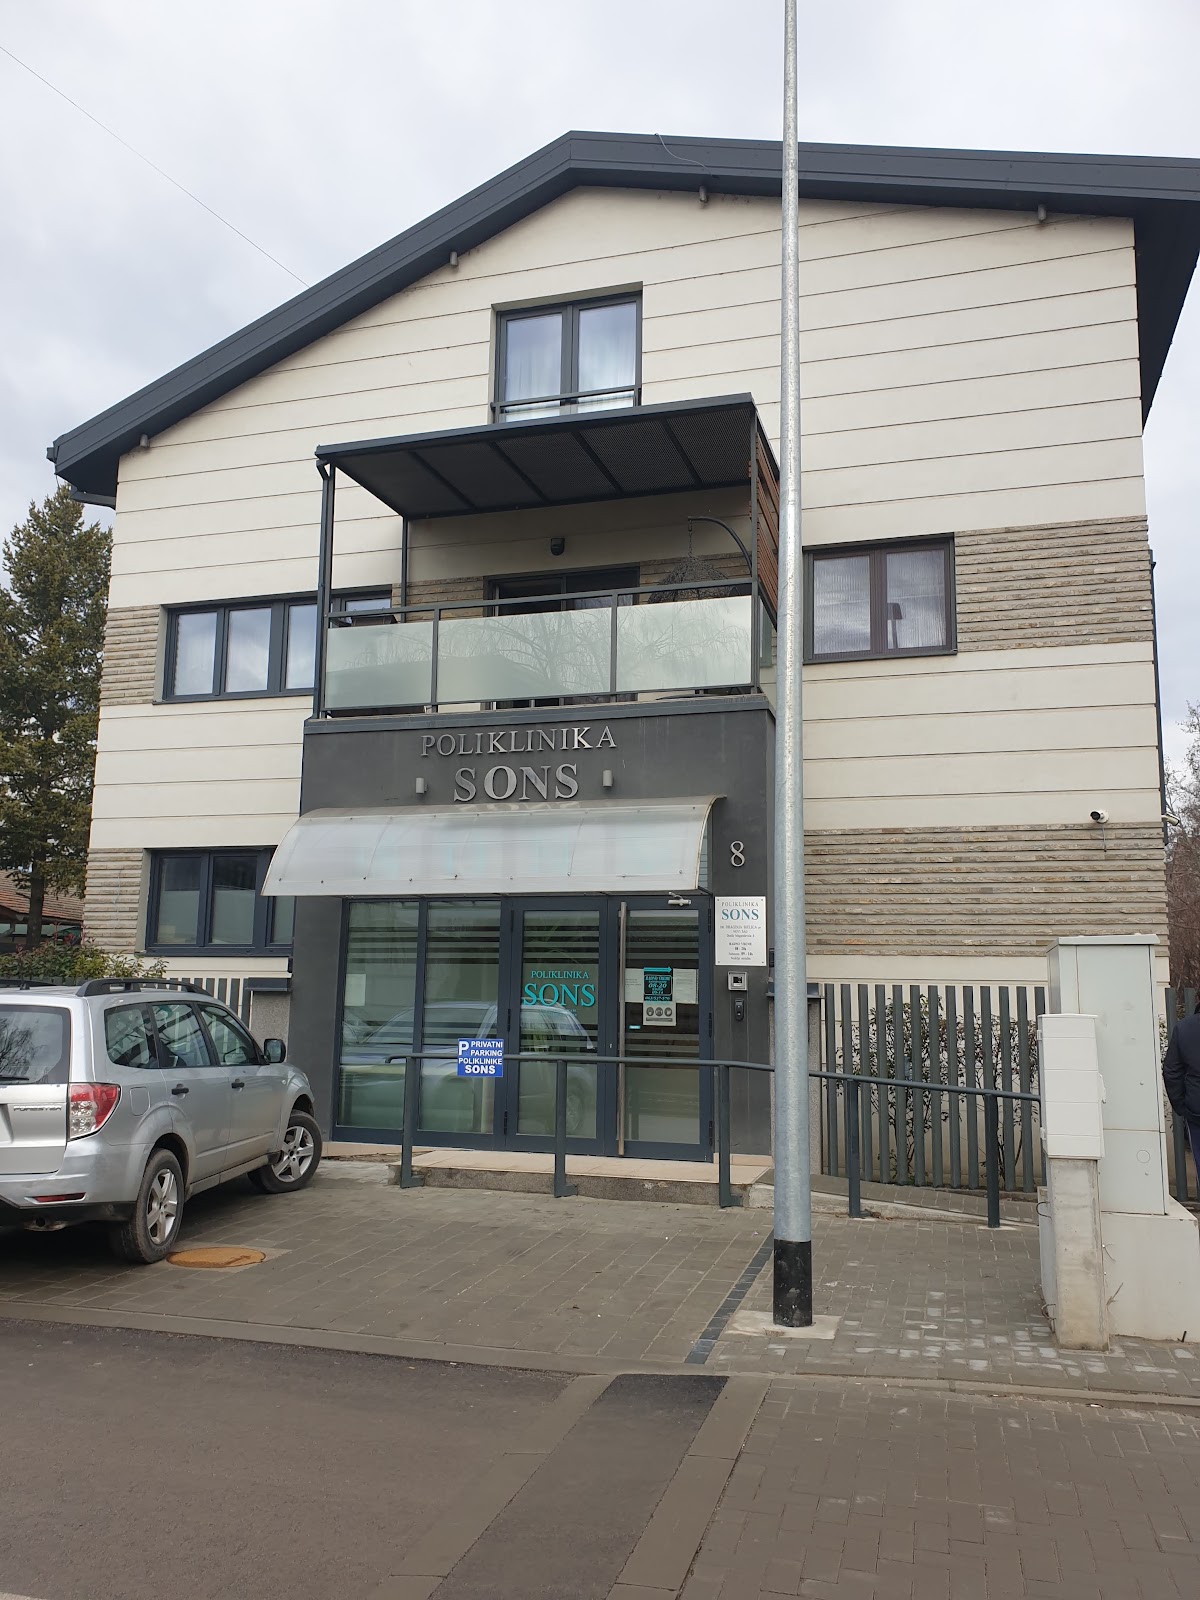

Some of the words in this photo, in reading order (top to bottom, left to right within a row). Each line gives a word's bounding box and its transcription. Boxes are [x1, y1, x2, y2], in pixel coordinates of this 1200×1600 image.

[420, 725, 617, 757] POLIKLINIKA
[453, 763, 580, 802] SONS
[730, 840, 745, 867] 8
[721, 908, 759, 920] SONS
[531, 970, 589, 979] POLIKLINIKA
[523, 983, 595, 1007] SONS
[458, 1041, 469, 1056] P
[464, 1065, 496, 1075] SONS
